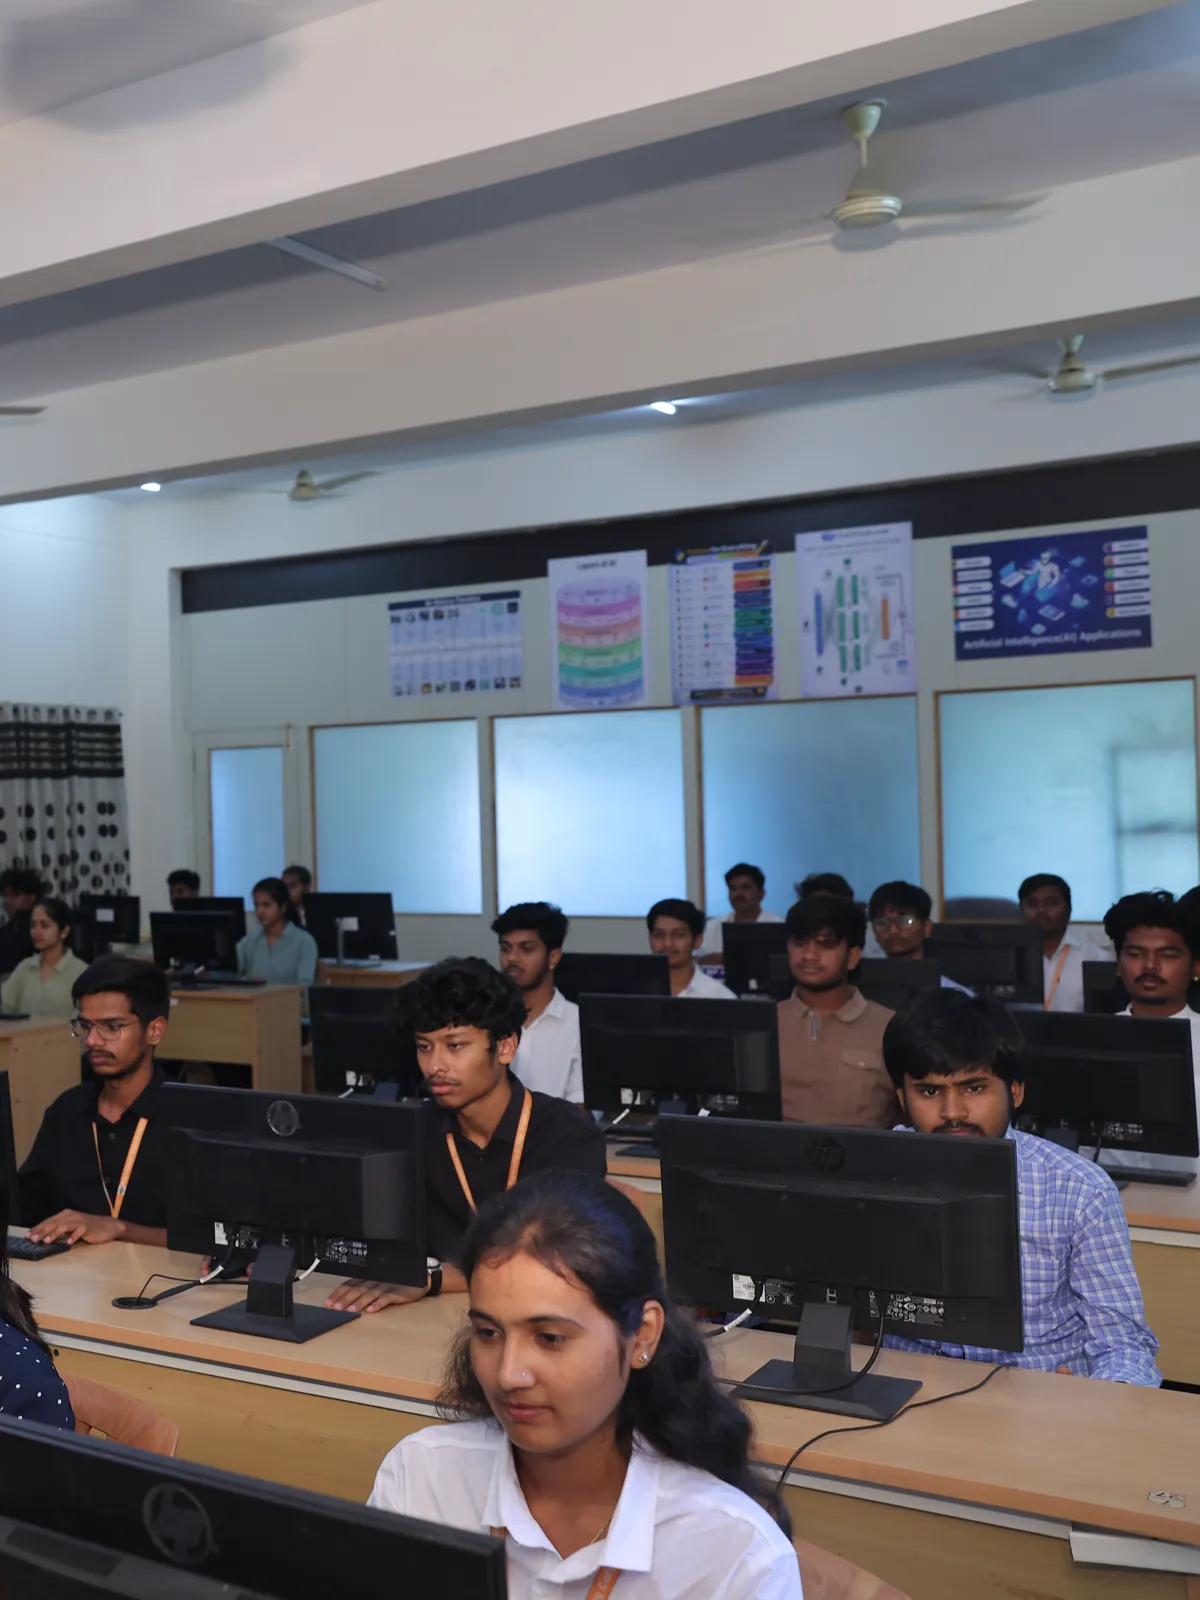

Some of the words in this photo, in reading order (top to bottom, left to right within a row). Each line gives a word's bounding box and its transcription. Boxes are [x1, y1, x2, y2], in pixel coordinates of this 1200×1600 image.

[964, 637, 1003, 649] Artificial
[1005, 632, 1078, 647] Intelligence(AI)
[1079, 628, 1142, 643] Applications
